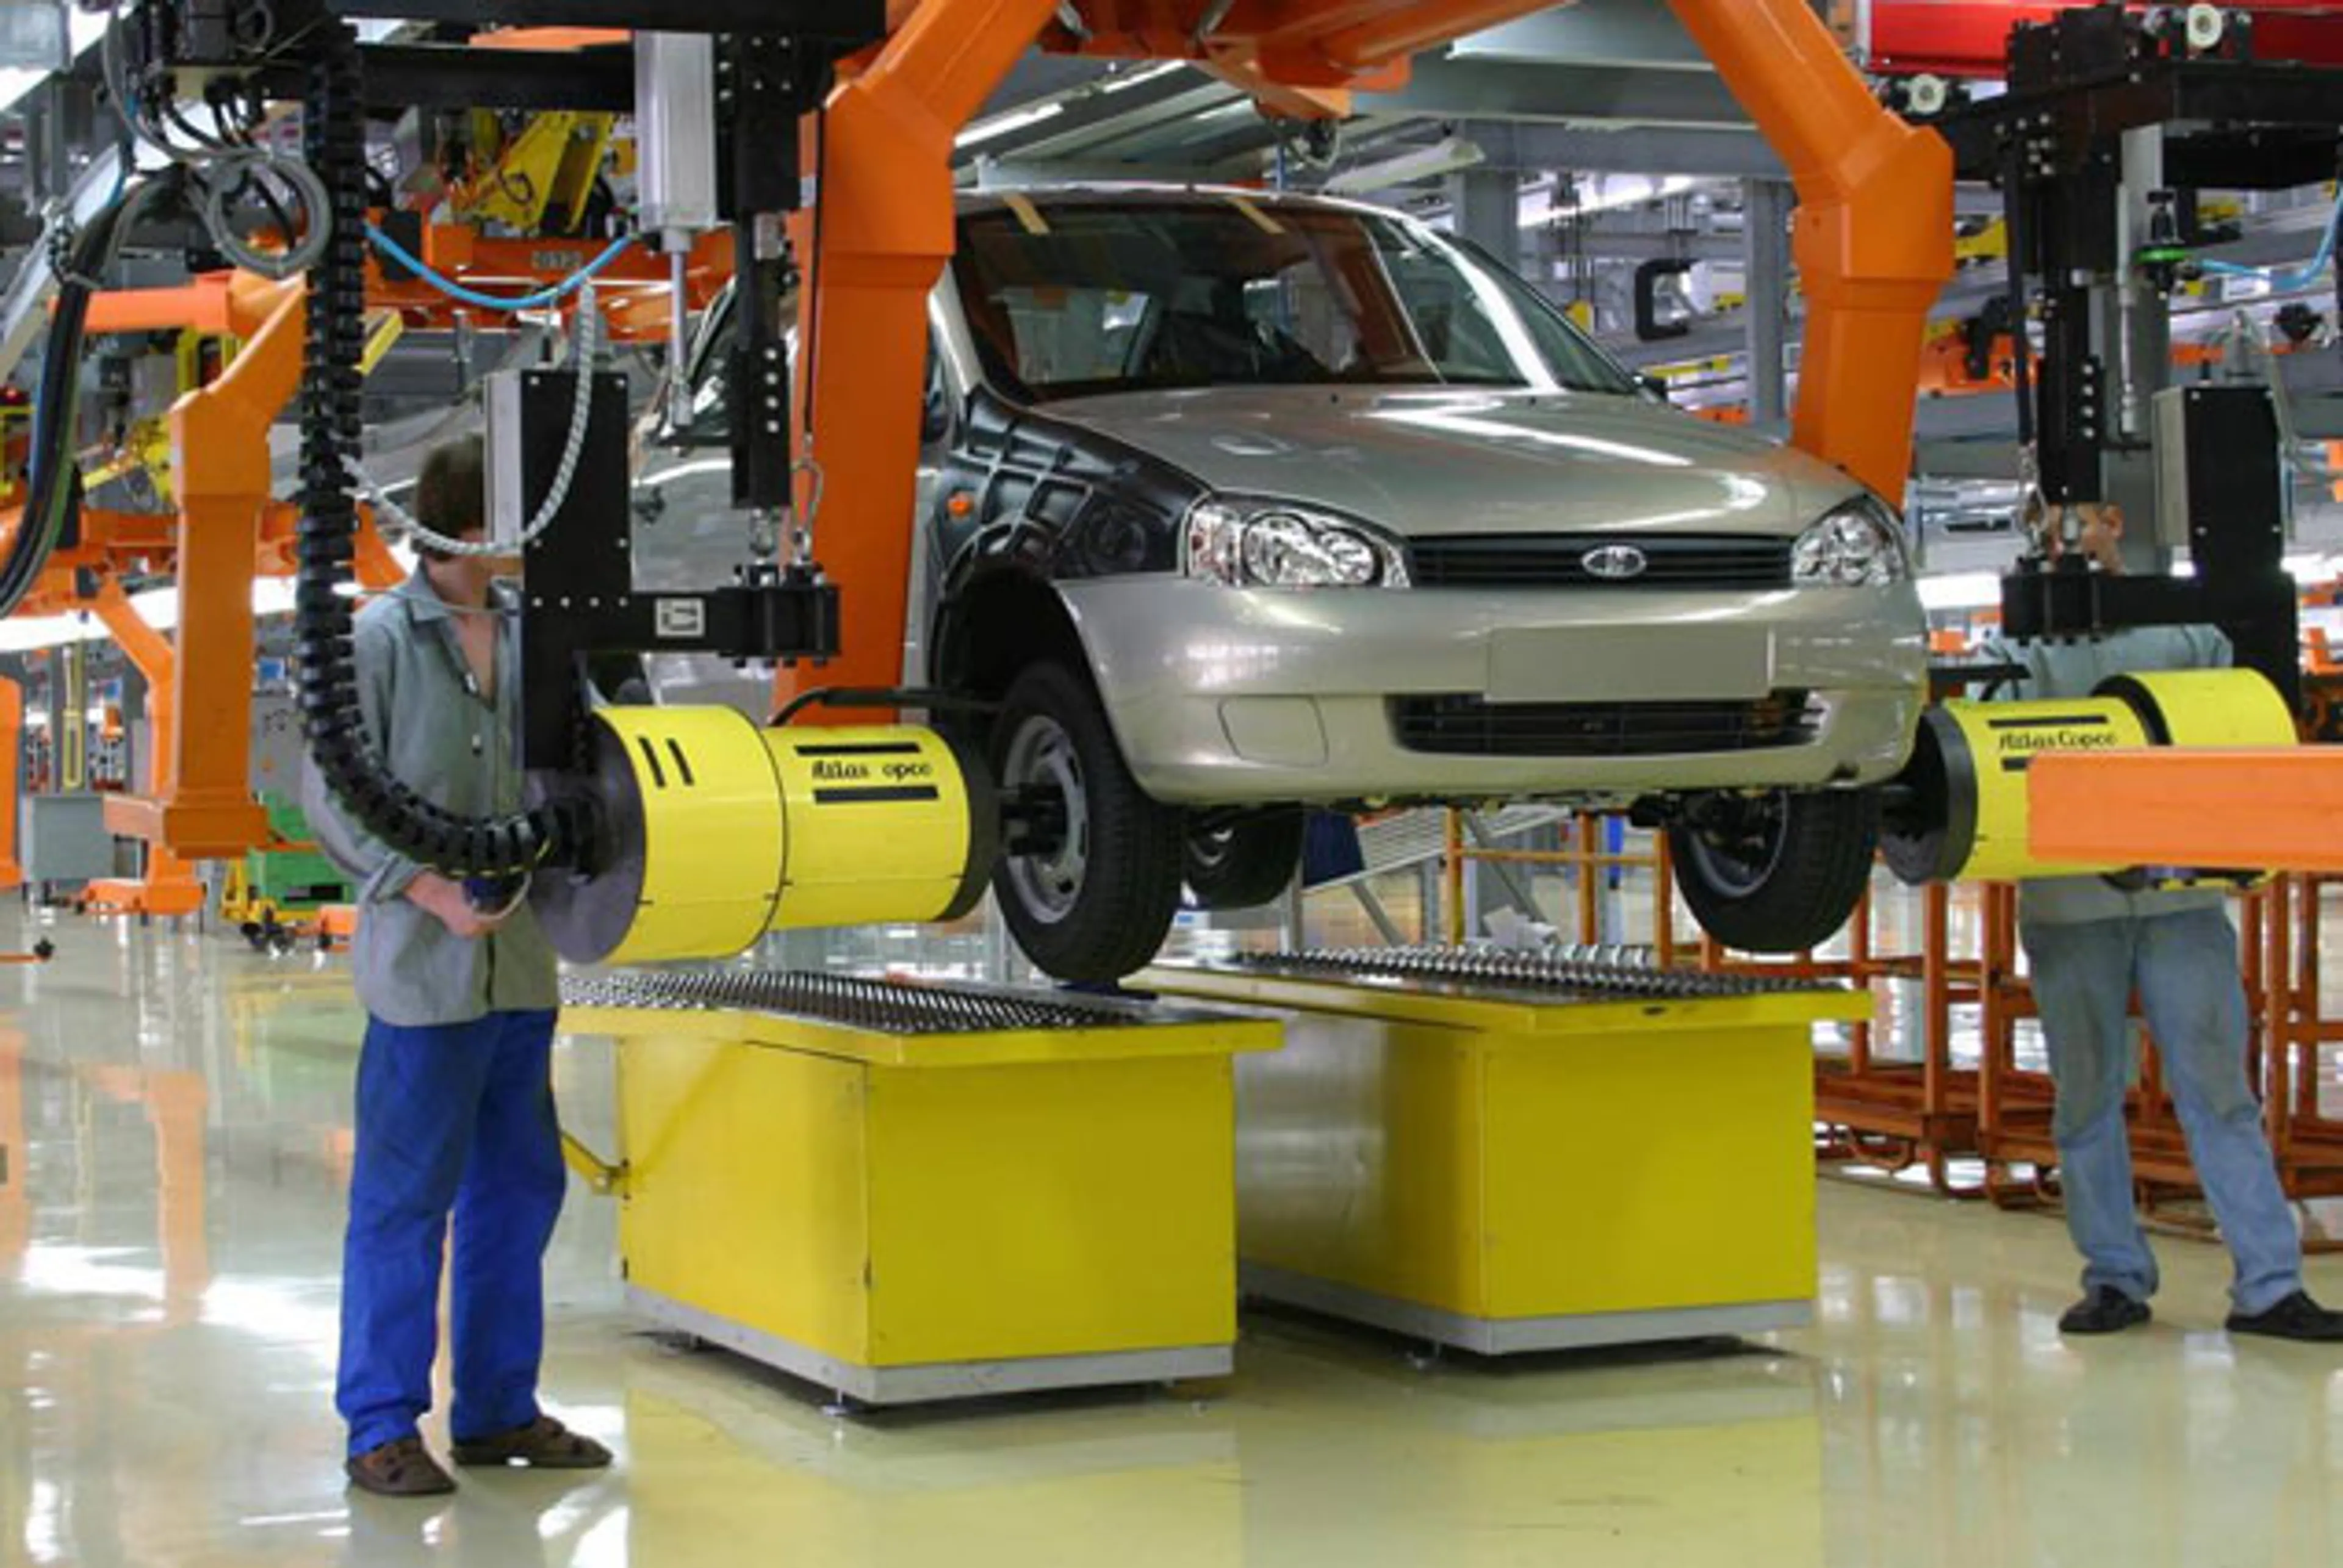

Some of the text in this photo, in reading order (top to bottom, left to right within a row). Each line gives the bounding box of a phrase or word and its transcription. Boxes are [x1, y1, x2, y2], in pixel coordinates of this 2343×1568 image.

[1999, 730, 2118, 749] Atlas Copco
[812, 760, 869, 779] Atlas
